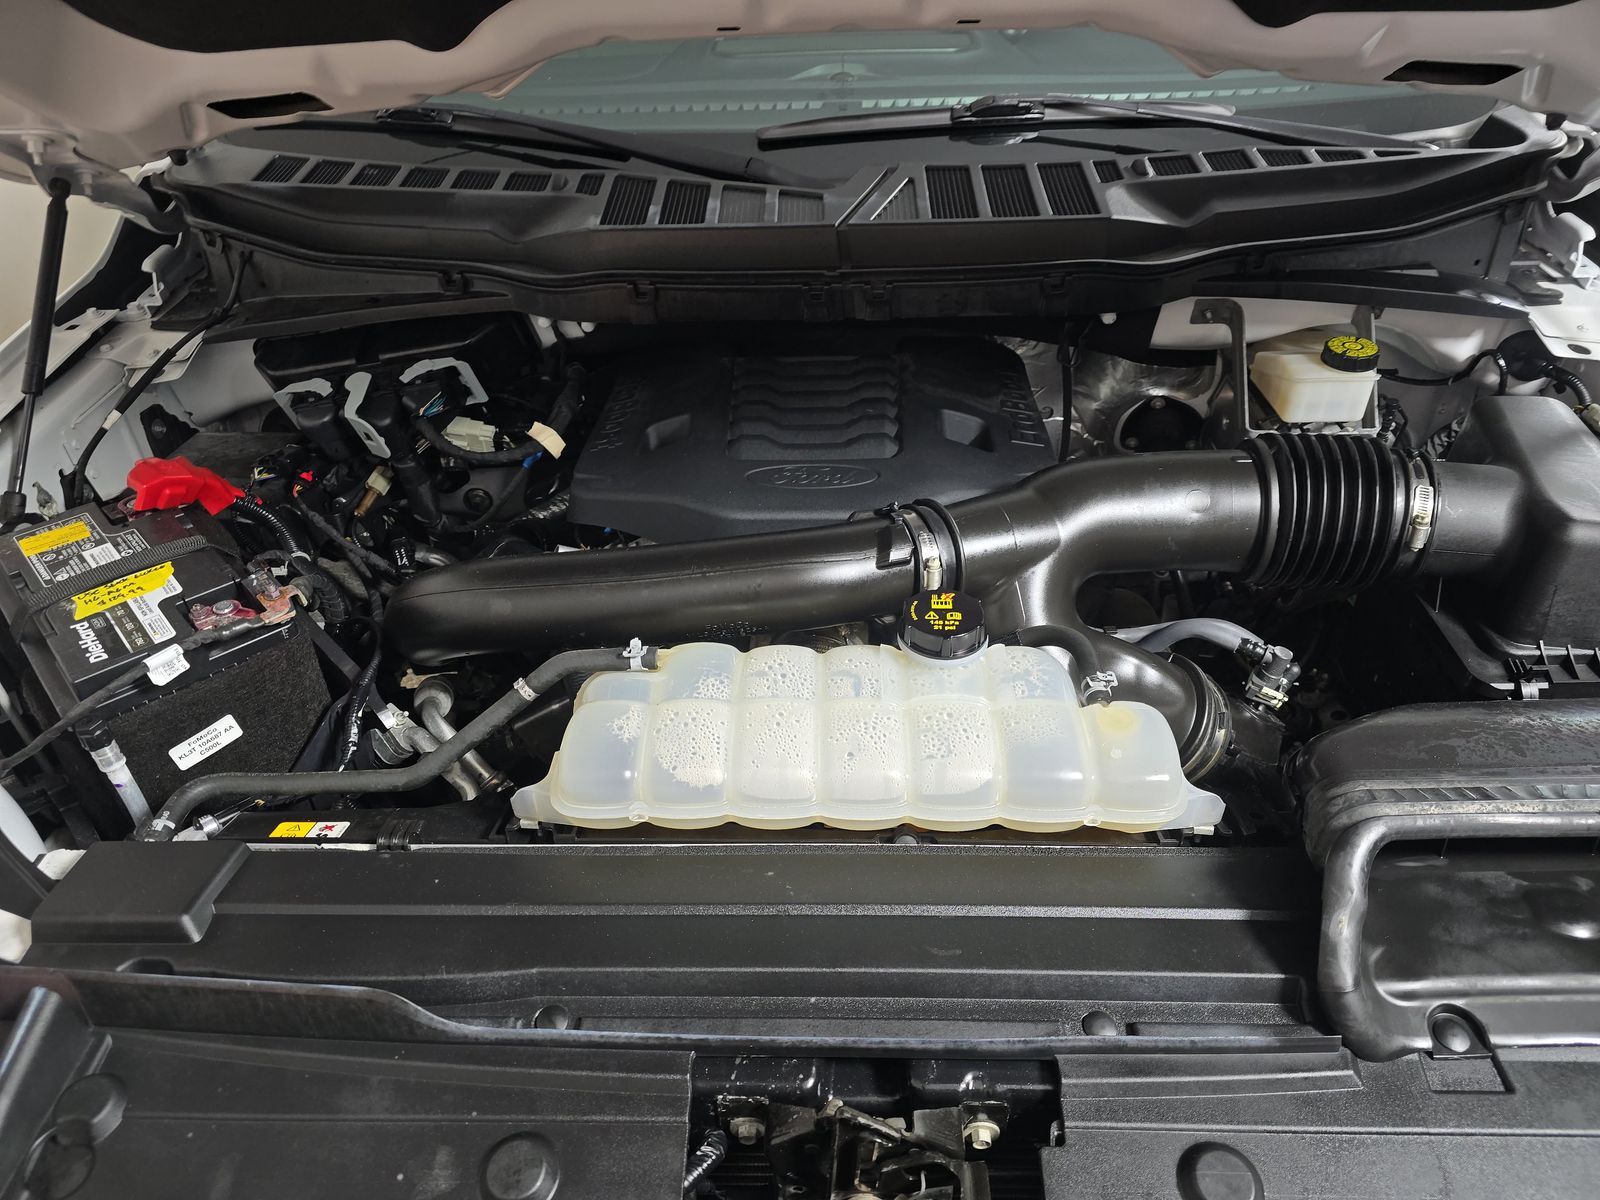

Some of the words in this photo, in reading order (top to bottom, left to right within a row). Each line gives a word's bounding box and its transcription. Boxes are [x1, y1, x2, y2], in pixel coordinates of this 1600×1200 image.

[770, 464, 858, 486] Ford
[69, 621, 109, 663] DieHard
[178, 746, 197, 760] KL3T
[224, 725, 235, 734] AA
[187, 727, 218, 747] FoMoCo
